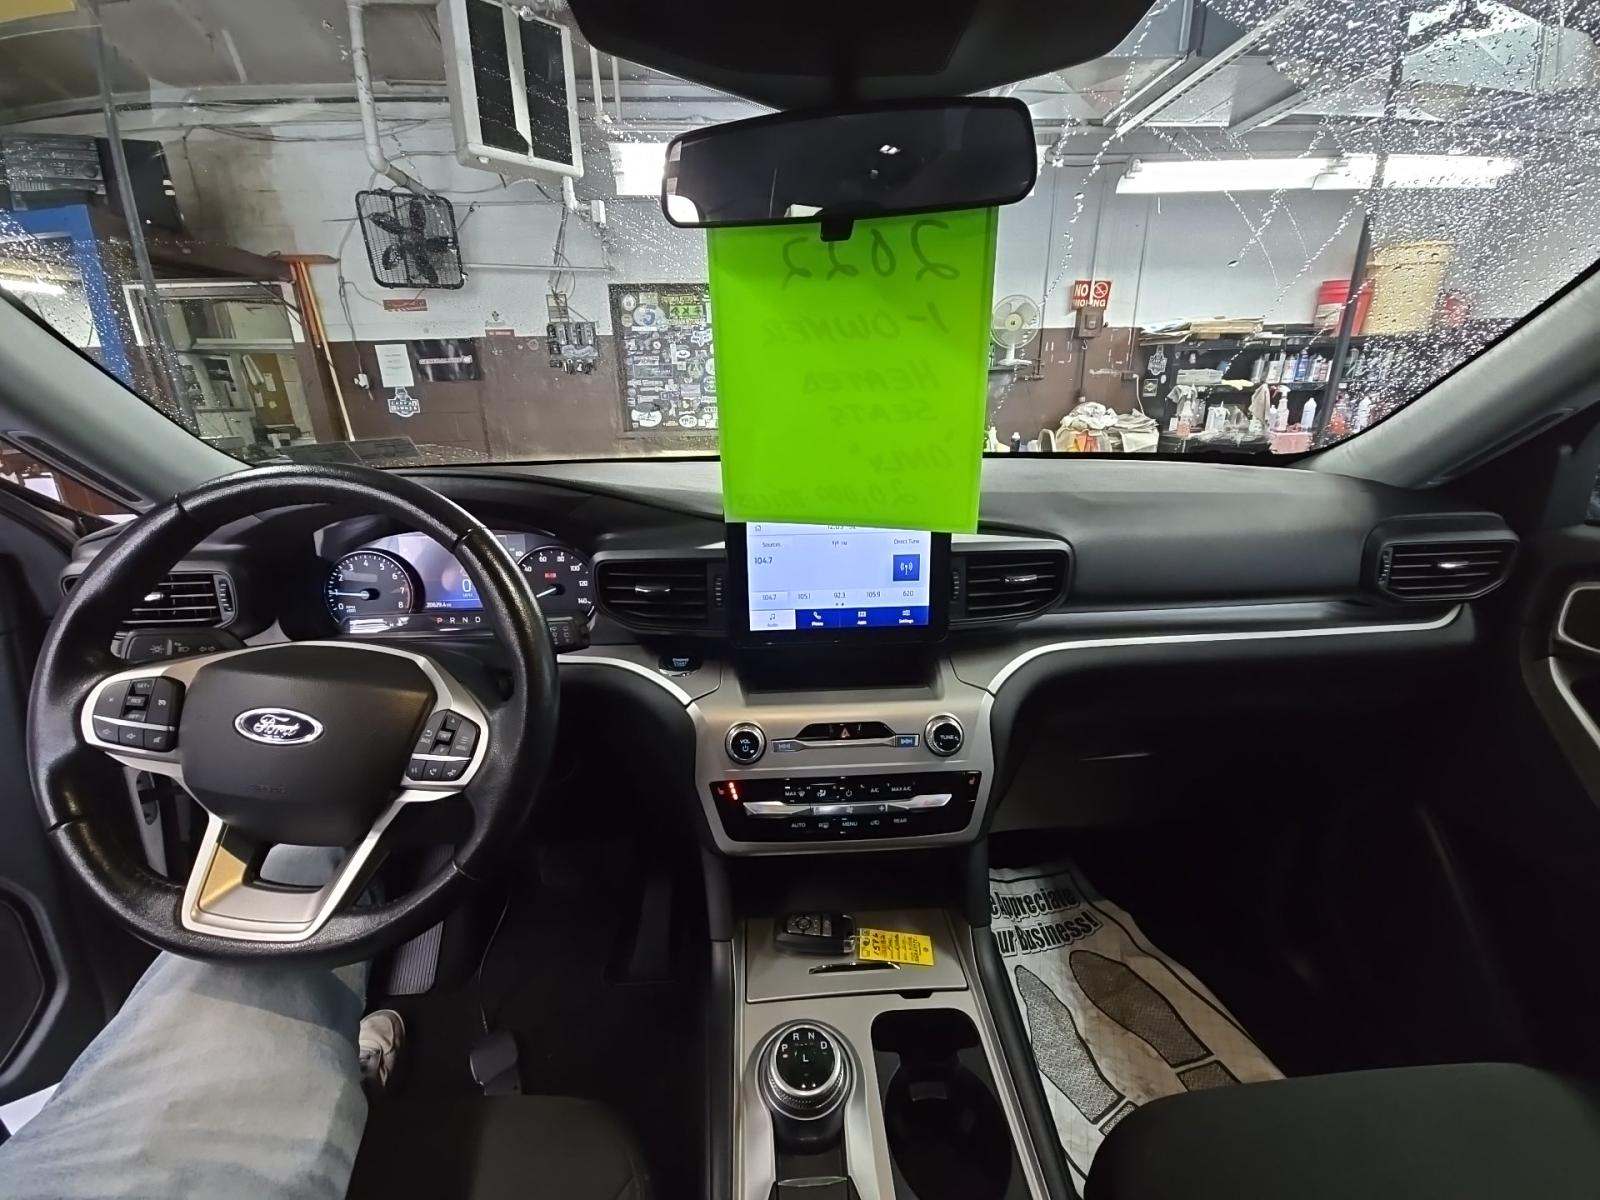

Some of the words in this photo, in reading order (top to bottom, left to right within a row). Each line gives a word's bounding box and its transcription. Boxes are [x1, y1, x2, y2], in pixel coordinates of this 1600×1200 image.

[1074, 283, 1089, 297] NO
[363, 559, 369, 567] 4
[754, 556, 773, 565] 104.7
[348, 563, 354, 571] 3
[338, 574, 344, 582] 2
[462, 578, 471, 592] 0
[338, 602, 344, 610] 0
[253, 714, 300, 737] Ford
[1014, 910, 1103, 952] Business!
[792, 1032, 800, 1041] R
[808, 1032, 815, 1040] N
[781, 1043, 789, 1052] P
[820, 1041, 828, 1050] D
[802, 1053, 809, 1062] L
